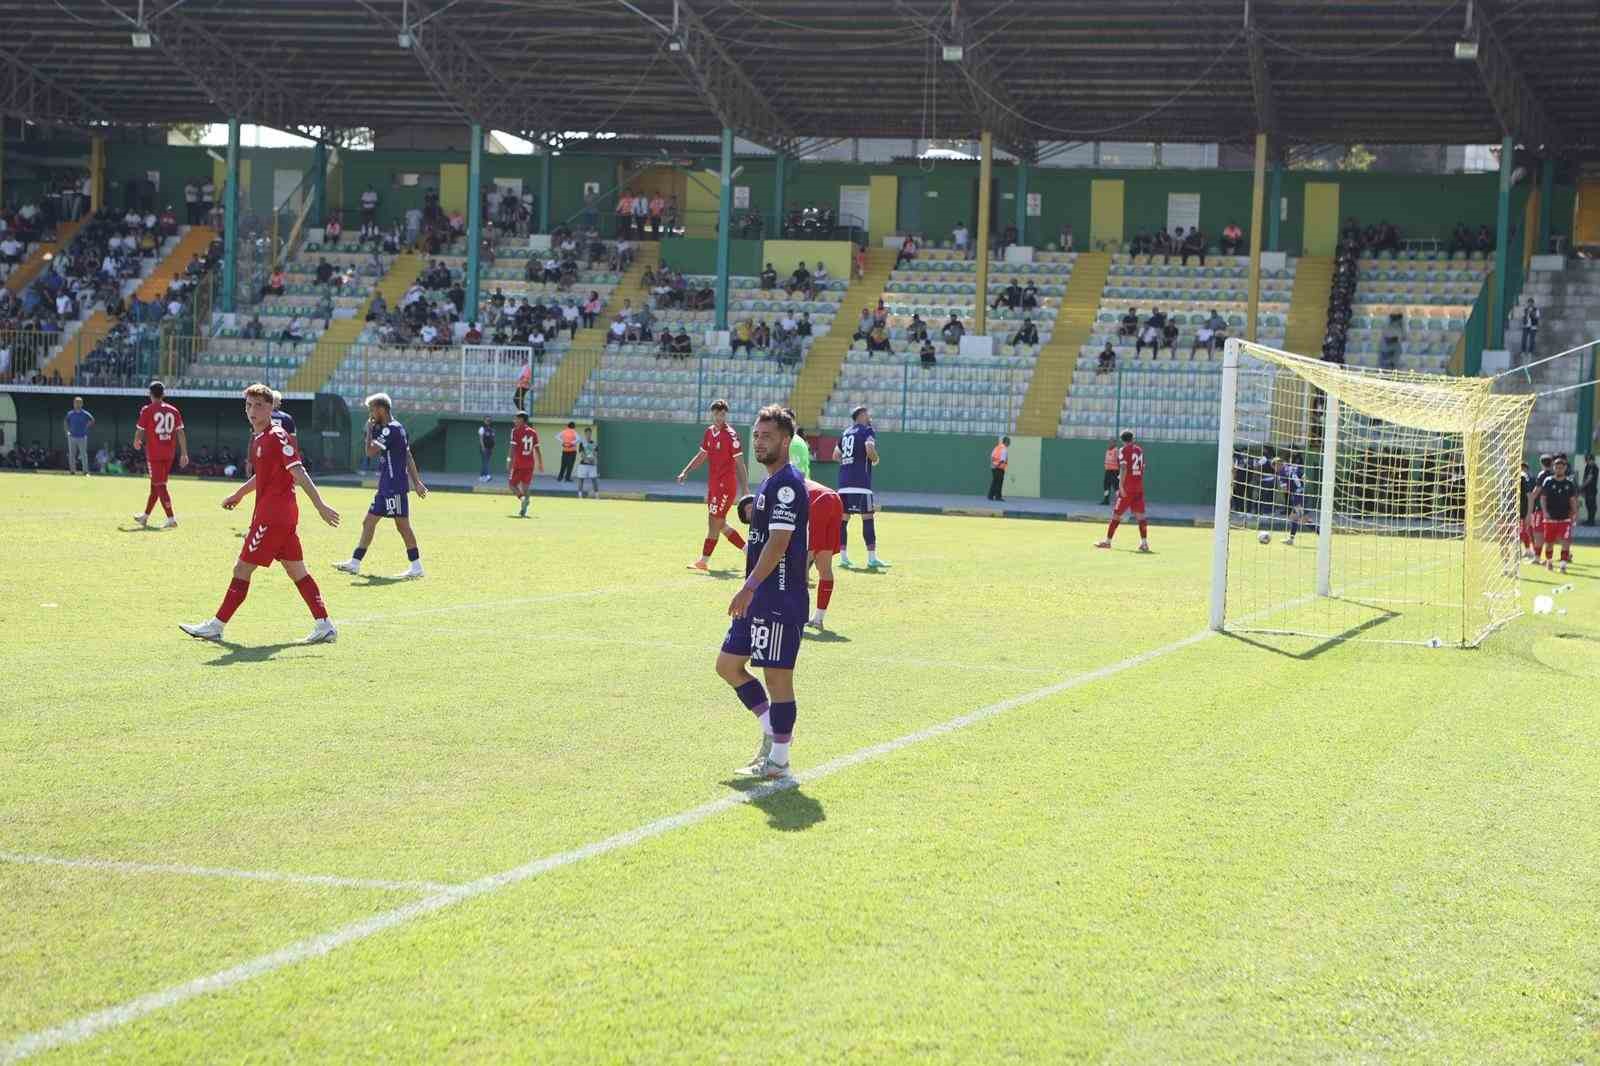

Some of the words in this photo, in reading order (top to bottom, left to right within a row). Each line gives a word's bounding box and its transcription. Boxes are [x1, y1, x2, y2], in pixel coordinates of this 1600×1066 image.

[153, 412, 174, 434] 20
[842, 434, 854, 458] 99
[1132, 453, 1143, 470] 21
[385, 498, 395, 510] 10
